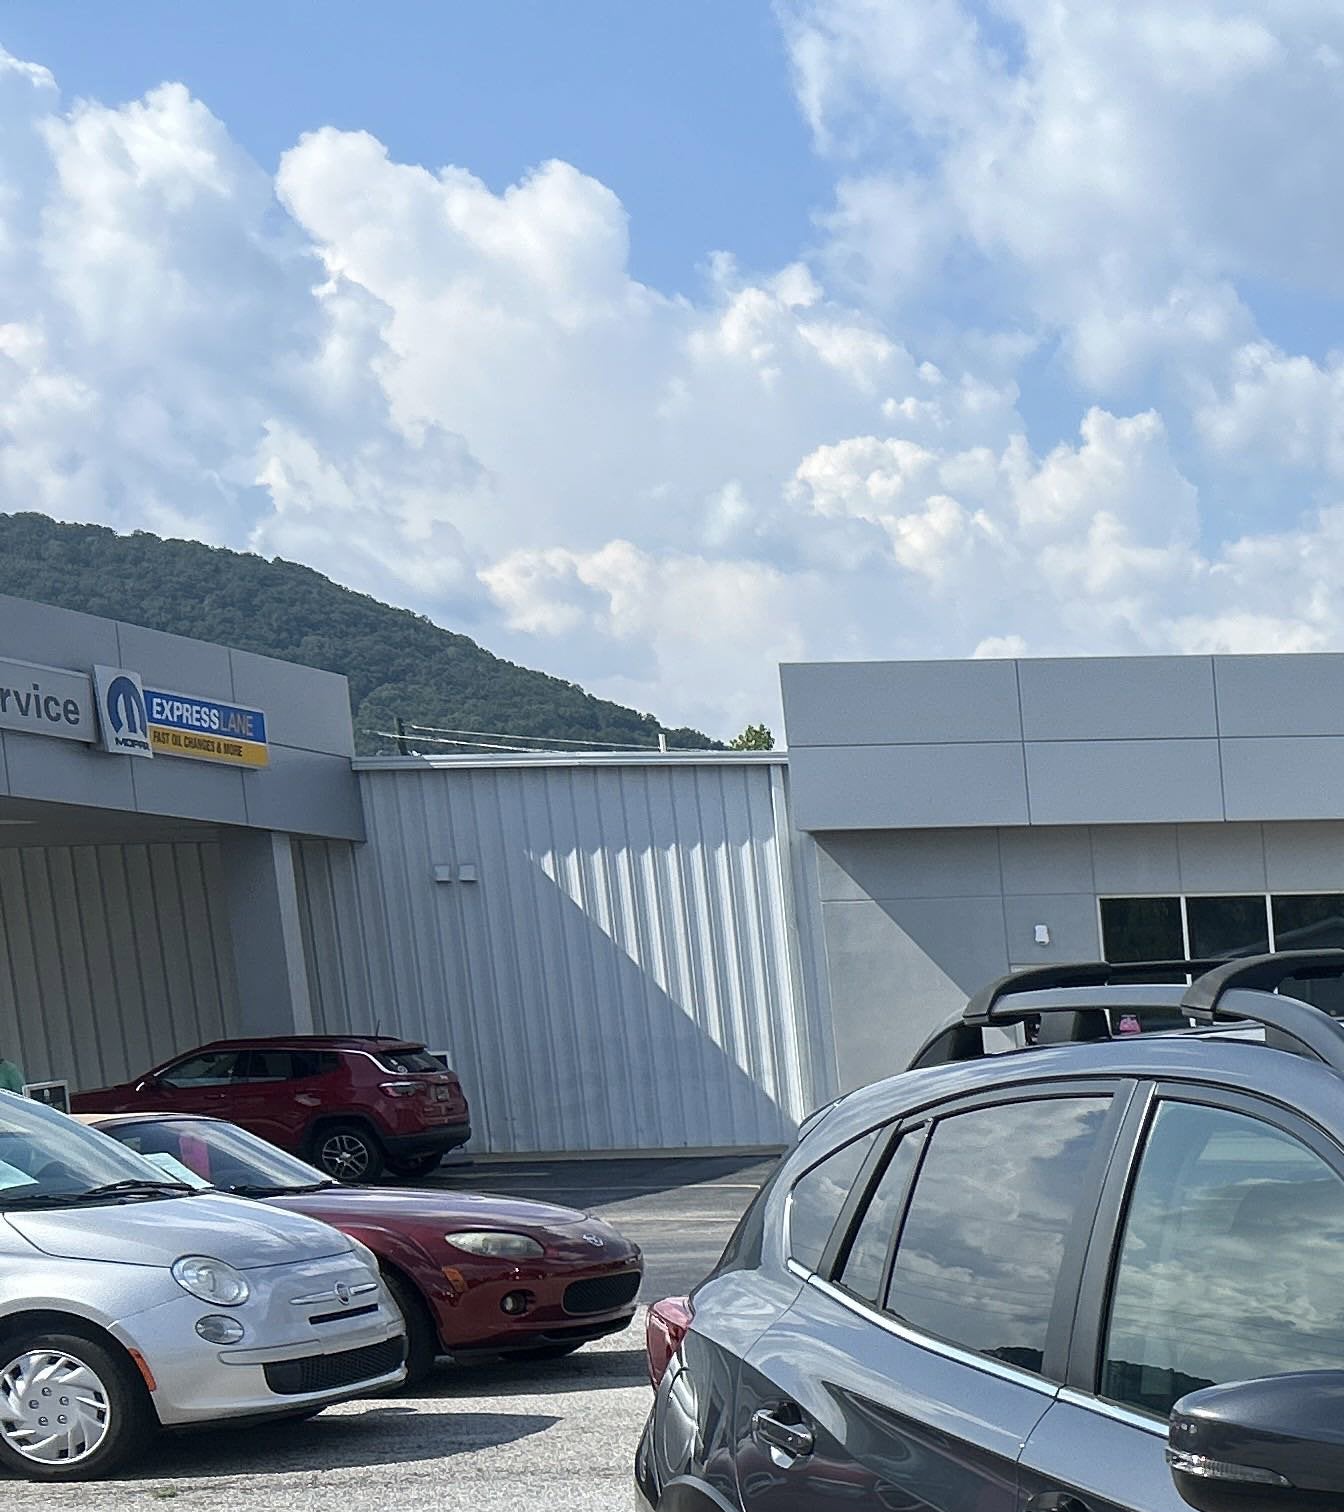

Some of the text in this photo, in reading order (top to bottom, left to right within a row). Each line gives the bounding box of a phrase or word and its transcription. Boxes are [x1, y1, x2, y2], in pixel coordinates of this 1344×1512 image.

[153, 730, 170, 744] FAST
[171, 733, 182, 747] OIL
[184, 735, 215, 753] CHANGES
[223, 744, 243, 757] MORE
